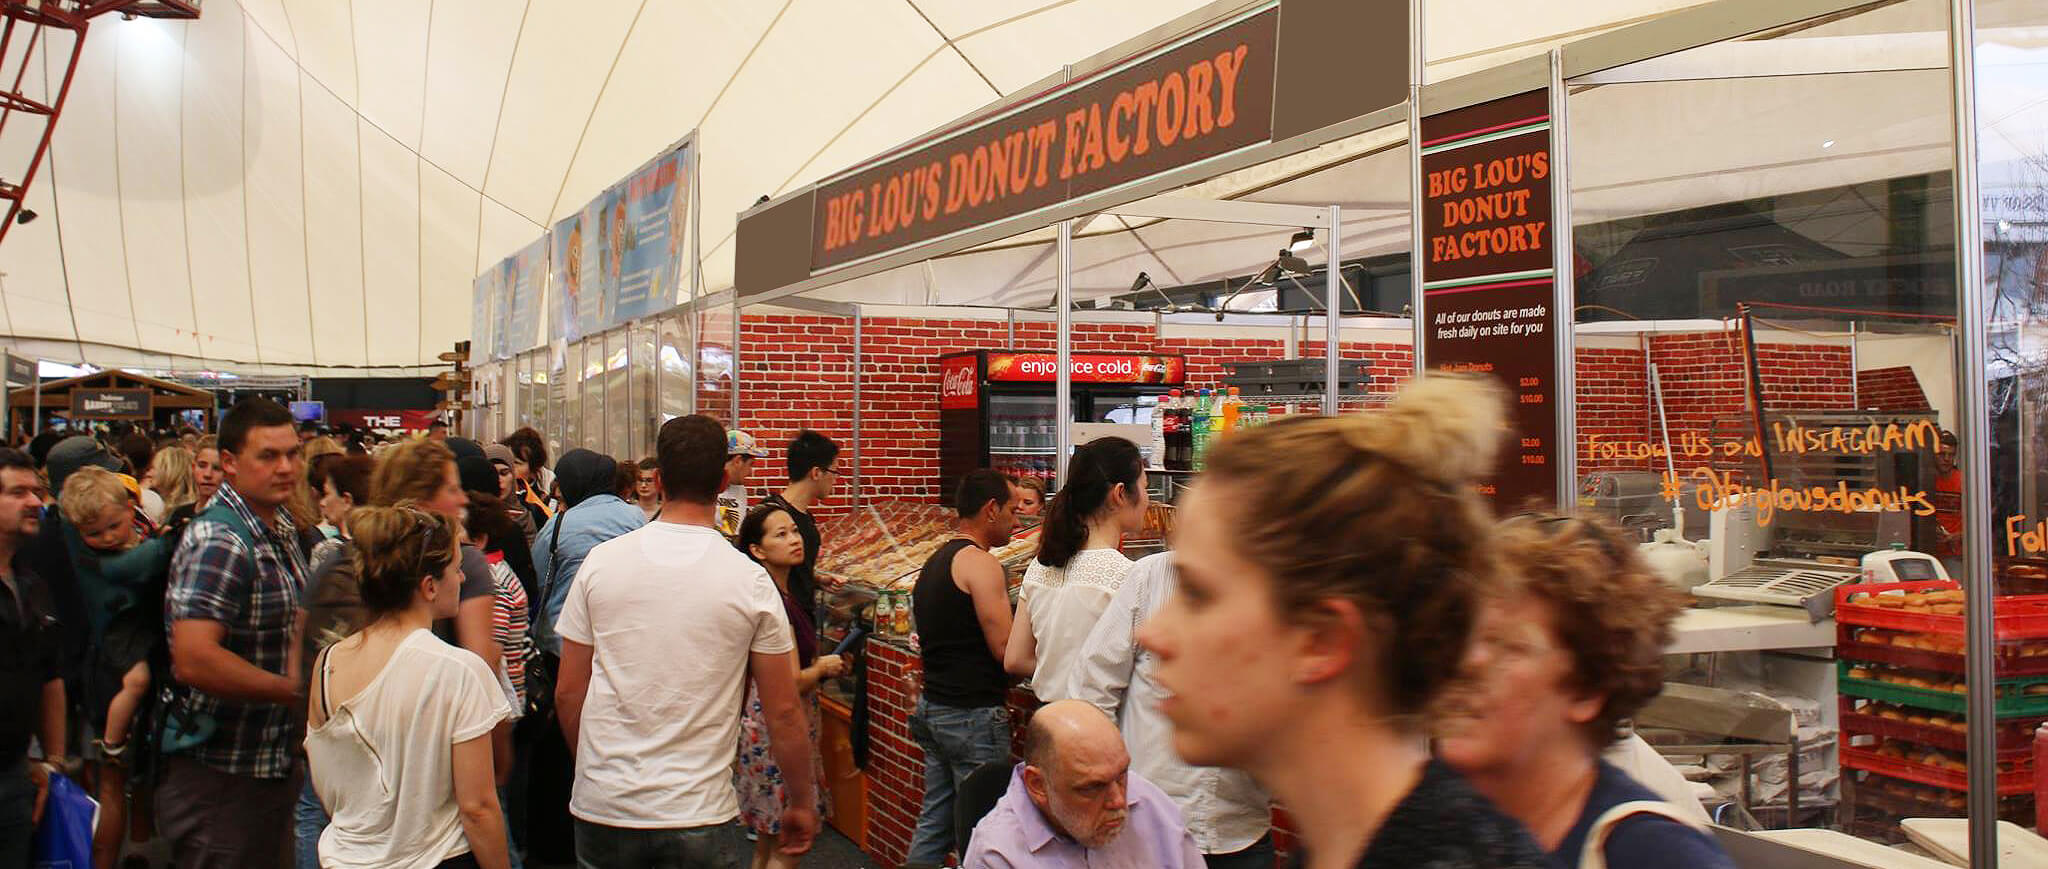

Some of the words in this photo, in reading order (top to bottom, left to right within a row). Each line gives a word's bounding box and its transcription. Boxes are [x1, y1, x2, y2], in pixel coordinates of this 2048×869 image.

[824, 191, 864, 251] BIG
[868, 161, 942, 238] LOU'S
[945, 119, 1058, 214] DONUT
[1059, 44, 1249, 180] FACTORY
[1428, 167, 1468, 198] BIG
[1474, 151, 1549, 189] LOU'S
[1443, 189, 1531, 228] DONUT
[1432, 222, 1545, 263] FACTORY
[1435, 313, 1446, 325] All
[1447, 312, 1456, 324] of
[1456, 313, 1471, 323] our
[1472, 309, 1501, 322] donuts
[1503, 309, 1518, 319] are
[1519, 304, 1546, 318] made
[1437, 328, 1457, 340] fresh
[1459, 325, 1479, 340] daily
[1480, 326, 1491, 337] on
[1492, 323, 1509, 336] site
[1510, 322, 1525, 335] for
[1525, 322, 1544, 337] you
[943, 366, 975, 397] Coca-Cola
[1021, 358, 1057, 376] enjo
[1070, 359, 1093, 374] ice
[363, 416, 401, 427] THE
